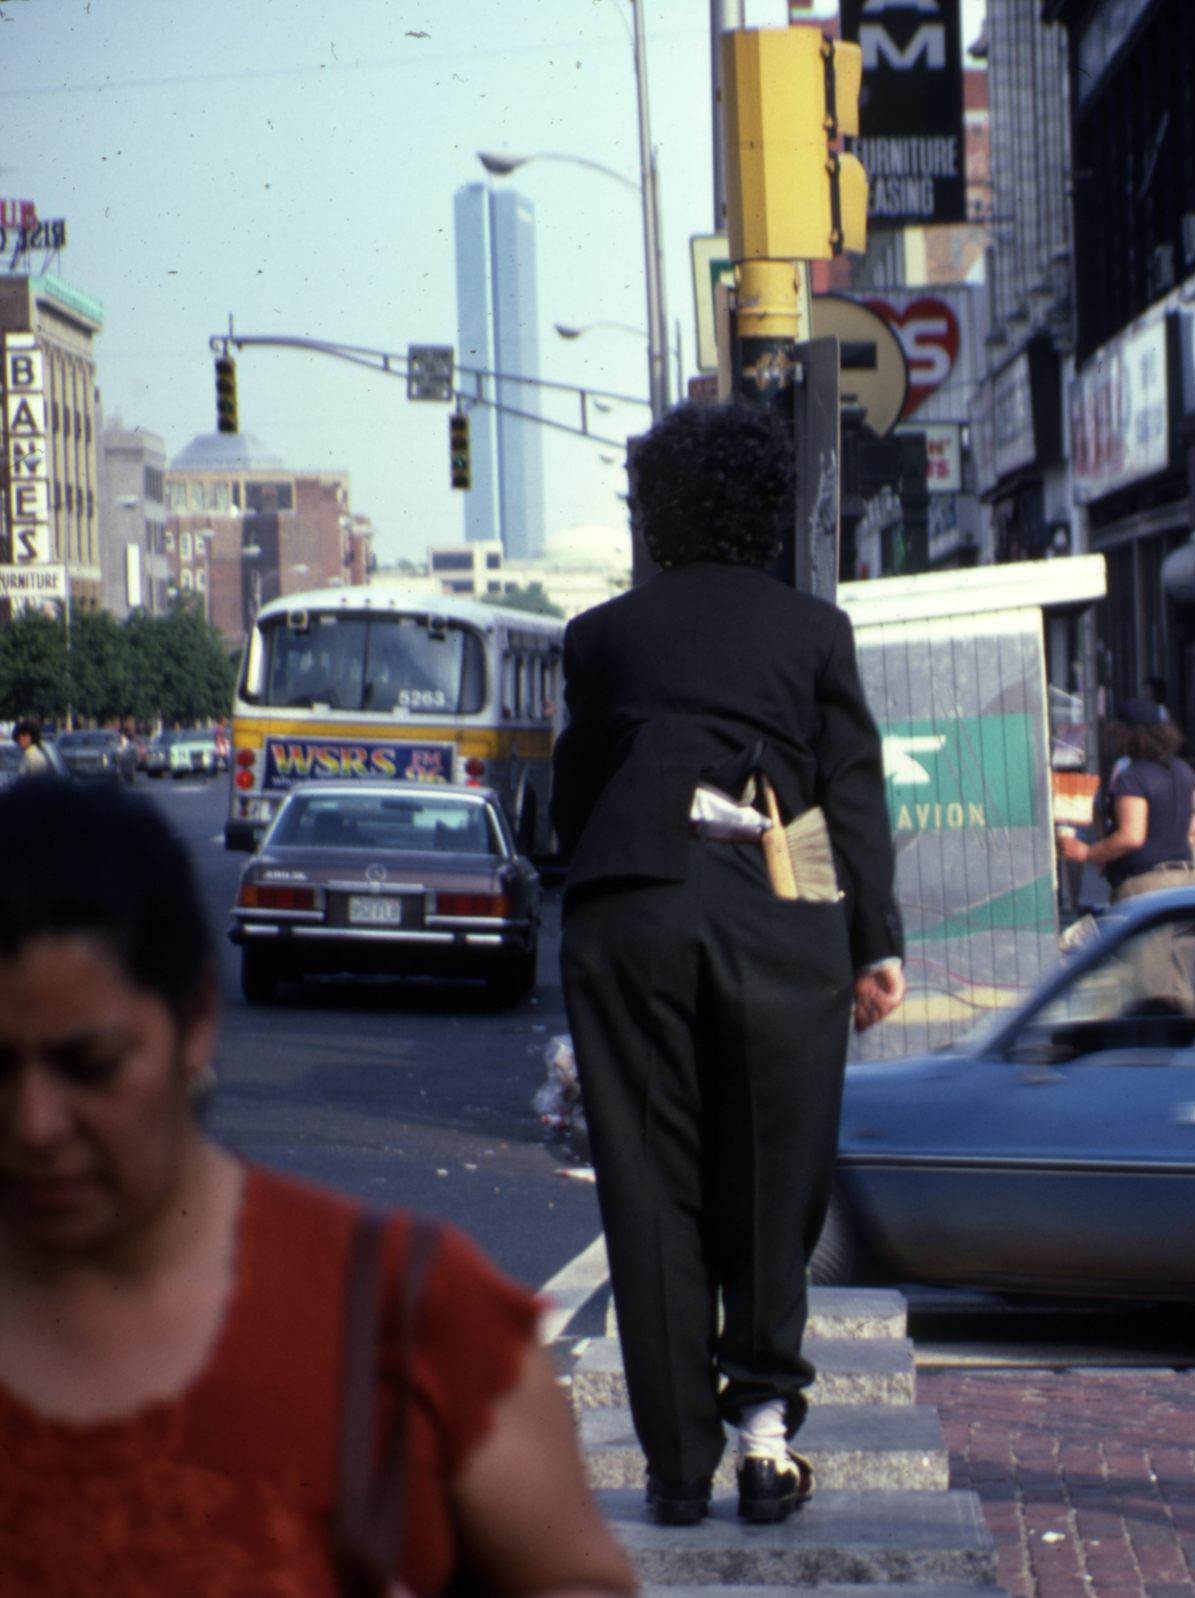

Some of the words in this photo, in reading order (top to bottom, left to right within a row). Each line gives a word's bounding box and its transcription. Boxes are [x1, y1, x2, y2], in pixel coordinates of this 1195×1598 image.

[866, 174, 934, 217] EASING
[0, 572, 58, 589] URNITURE
[400, 689, 445, 707] 5263
[271, 744, 397, 778] WSRS
[412, 751, 442, 766] FM
[897, 802, 986, 830] AVION
